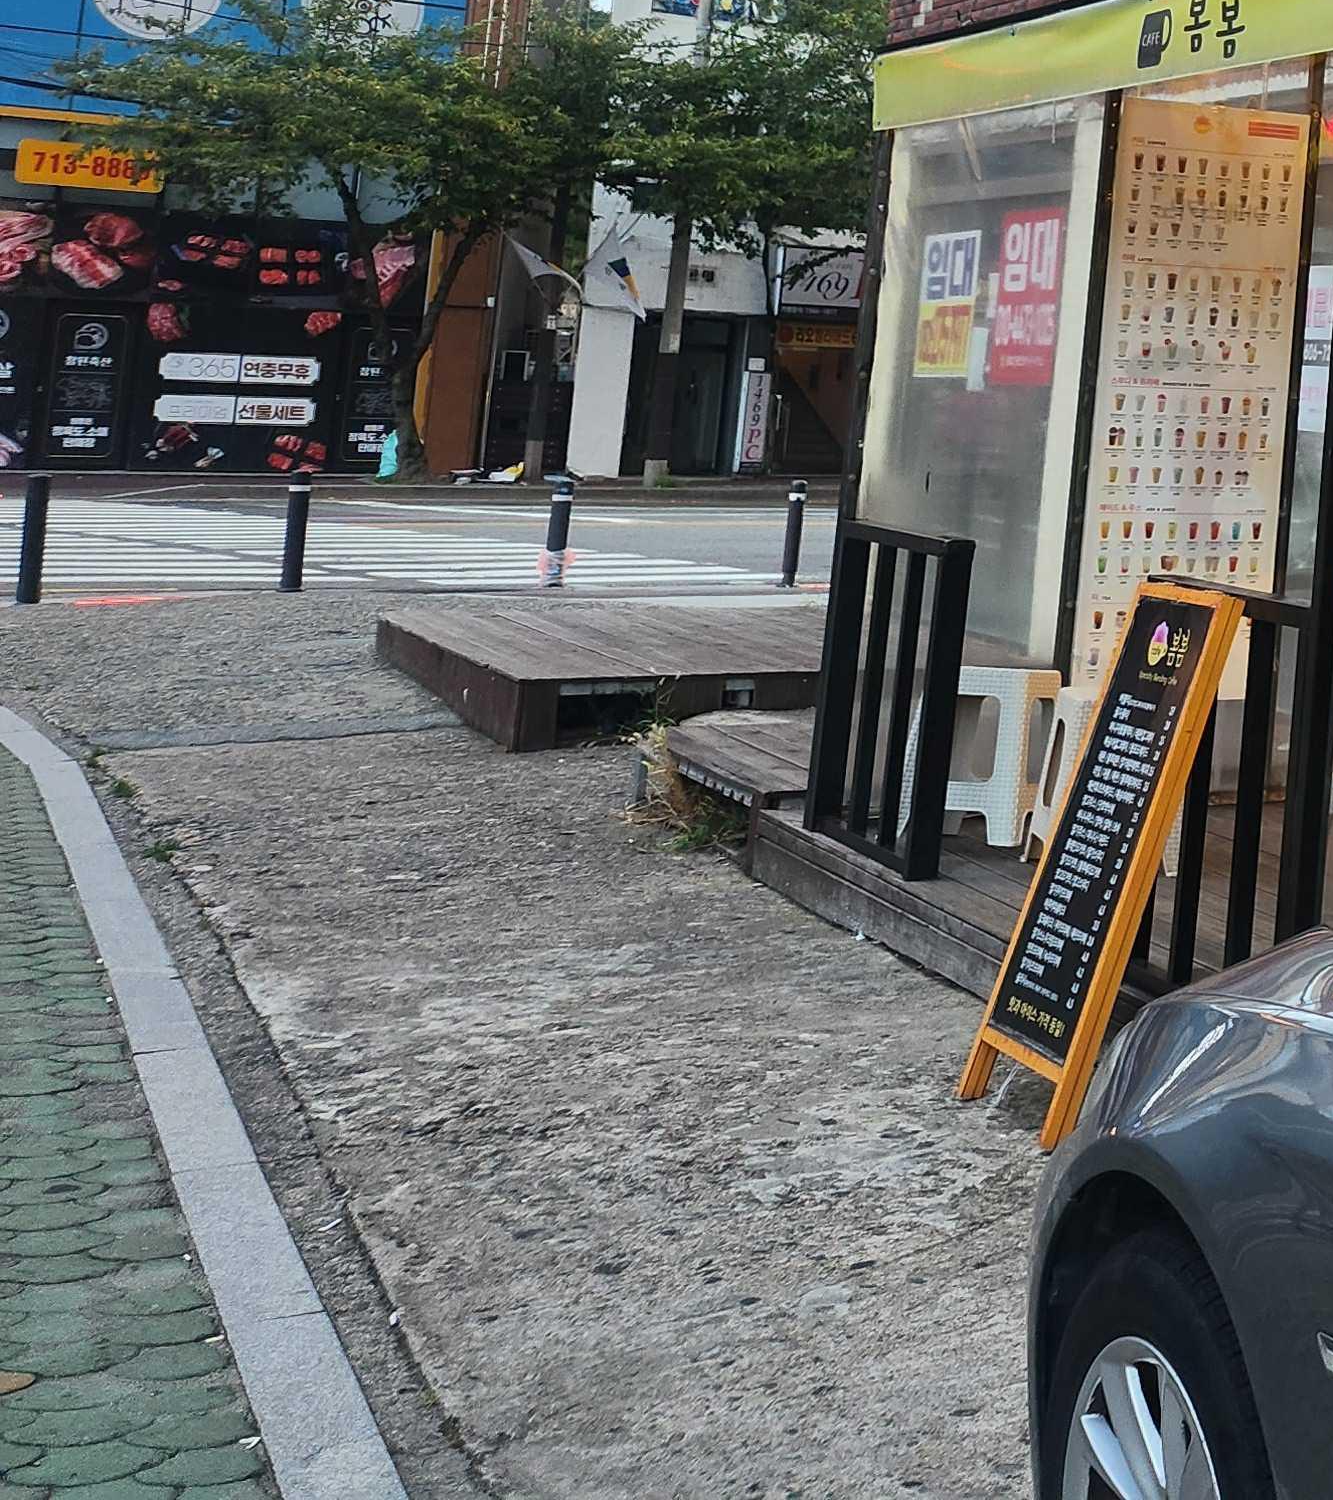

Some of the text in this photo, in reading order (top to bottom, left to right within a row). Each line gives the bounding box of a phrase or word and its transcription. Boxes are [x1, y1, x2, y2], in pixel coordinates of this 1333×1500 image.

[1141, 30, 1161, 47] CAFE
[1003, 219, 1061, 293] 임대
[926, 237, 977, 300] 임대
[187, 356, 311, 380] 365 연중무휴
[237, 403, 306, 421] 선물세트
